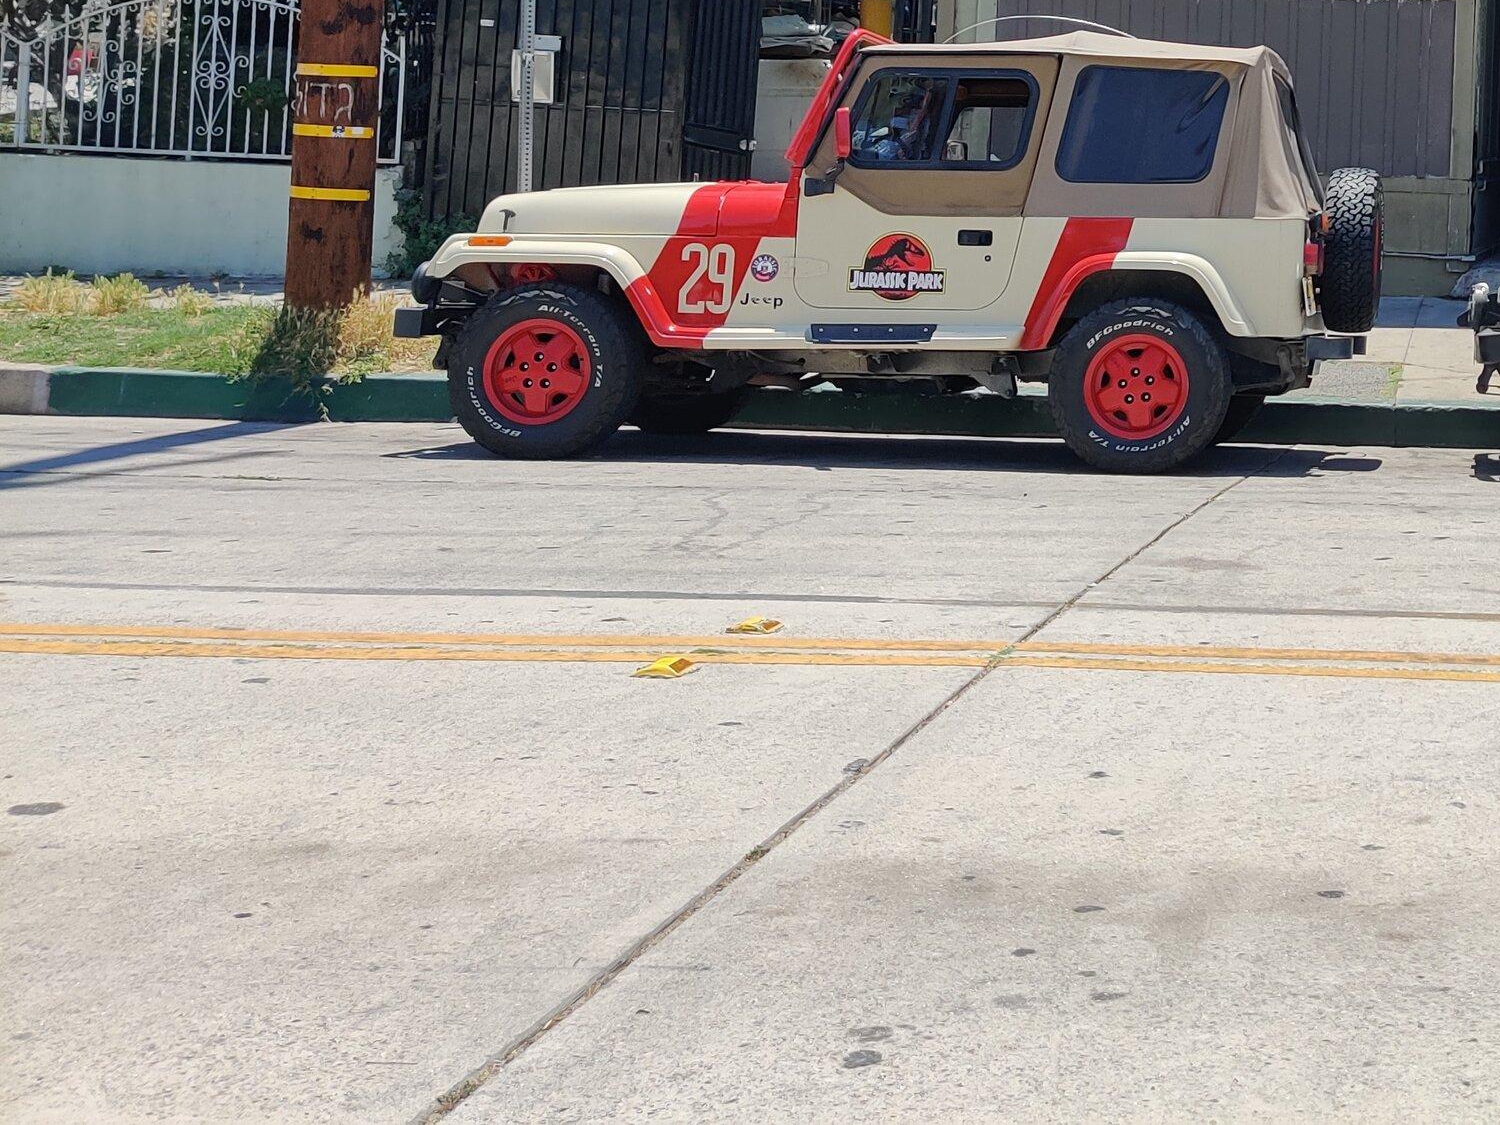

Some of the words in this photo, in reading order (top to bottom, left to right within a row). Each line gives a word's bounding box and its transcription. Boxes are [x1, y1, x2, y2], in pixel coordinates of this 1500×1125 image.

[678, 242, 736, 315] 29
[850, 270, 907, 290] JURASSIC
[907, 271, 944, 291] PARK
[740, 292, 784, 310] Jeep
[537, 304, 601, 357] All-Terrain
[594, 363, 604, 388] T/A
[1086, 319, 1174, 350] BFGoodrich
[466, 366, 522, 438] BFGoodrich
[1088, 429, 1110, 449] T/A
[1115, 415, 1190, 452] All-Terrain
